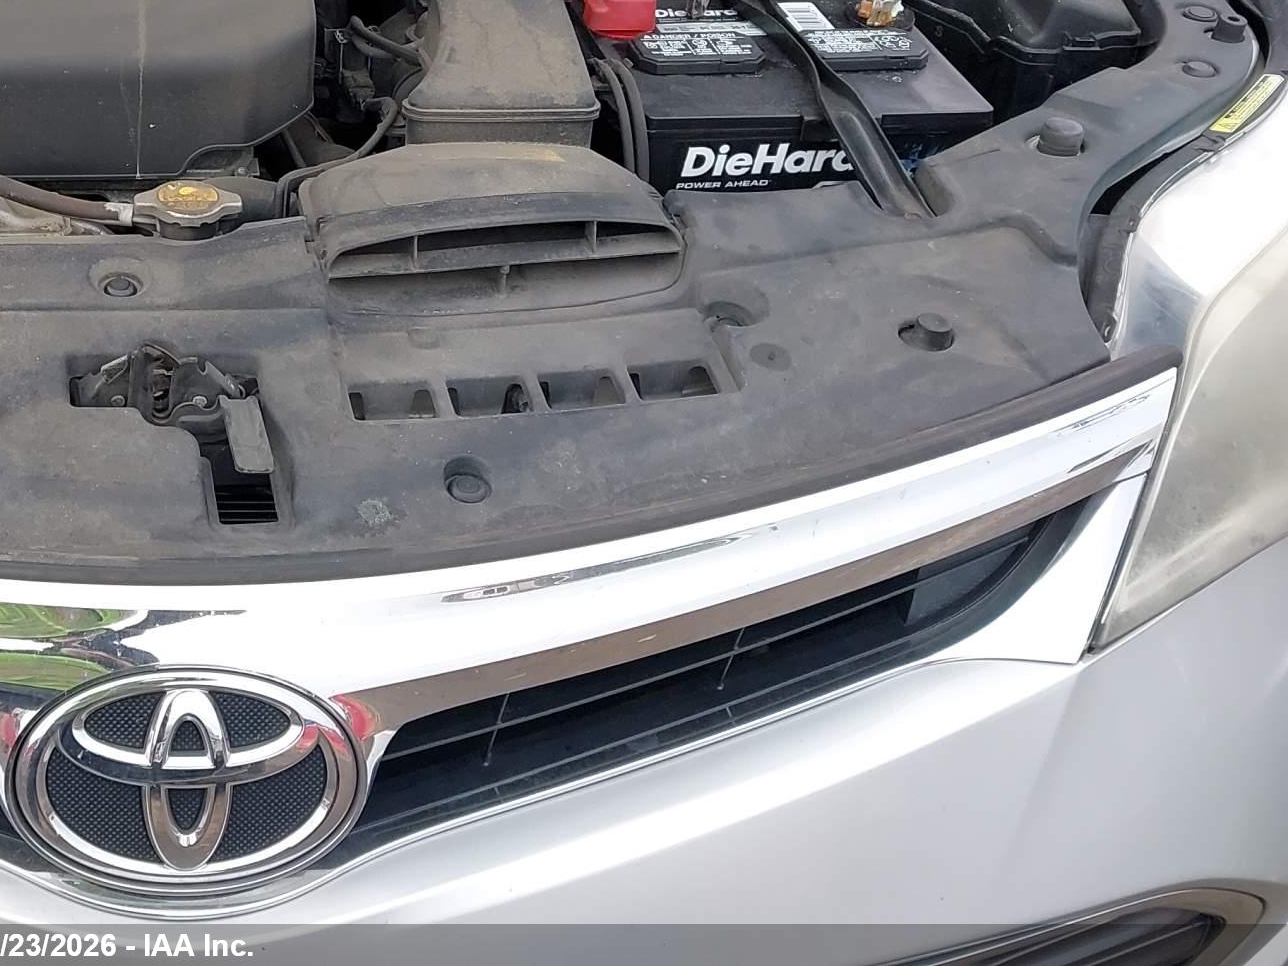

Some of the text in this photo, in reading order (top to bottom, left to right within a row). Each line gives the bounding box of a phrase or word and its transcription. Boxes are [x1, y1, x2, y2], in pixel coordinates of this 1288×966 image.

[655, 8, 739, 18] Dieard
[675, 179, 769, 190] POWER AHEAD
